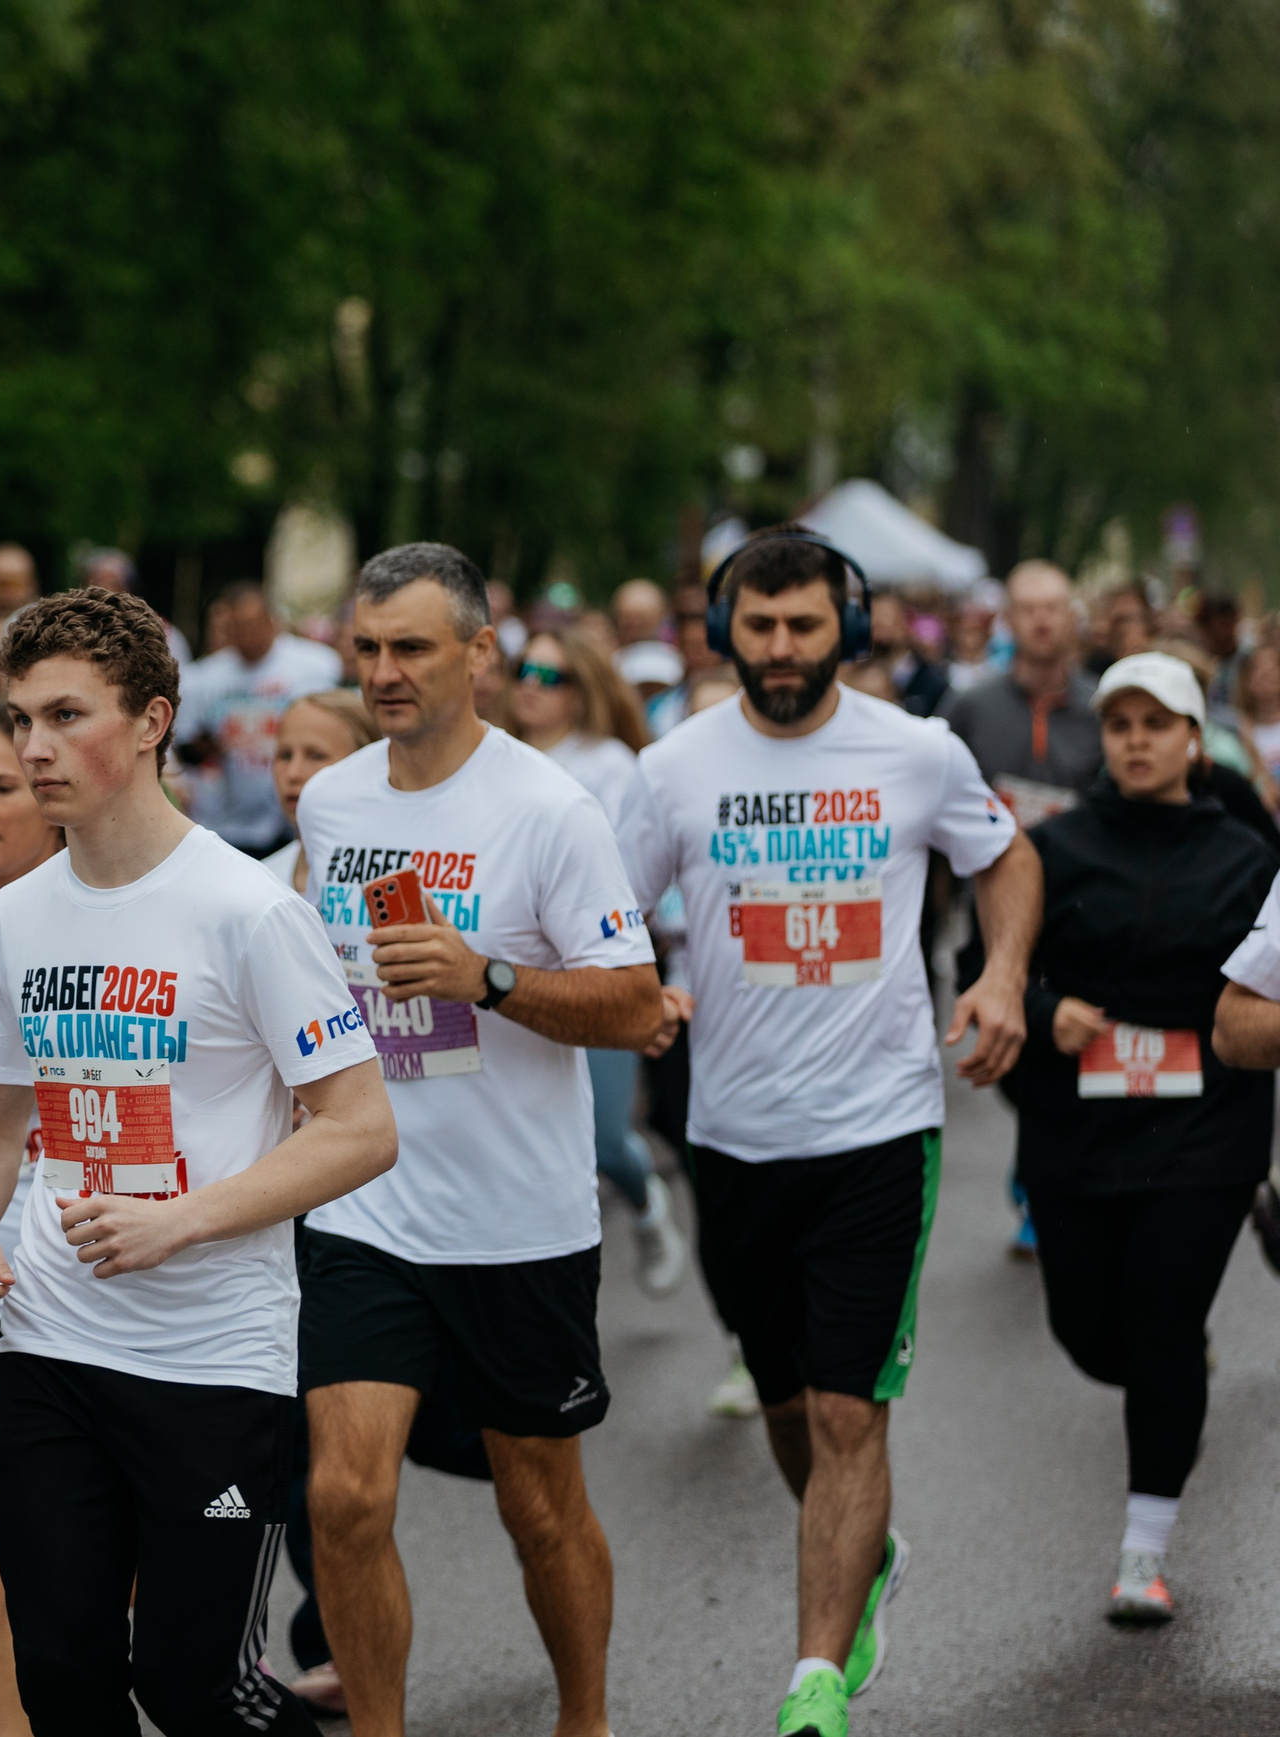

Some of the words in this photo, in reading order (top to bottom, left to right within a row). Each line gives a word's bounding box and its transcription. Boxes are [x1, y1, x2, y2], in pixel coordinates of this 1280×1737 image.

[717, 788, 882, 827] #ЗАБЕГ2025
[710, 830, 760, 866] 45%
[767, 825, 891, 862] ПЛАНЕТЫ
[784, 904, 840, 951] 614
[21, 965, 178, 1017] #ЗАБЕГ2025
[362, 987, 434, 1037] 1440
[56, 1013, 188, 1063] ПЛАНЕТЫ
[49, 1067, 66, 1077] ПСБ
[69, 1087, 122, 1144] 994
[204, 1505, 251, 1519] adidas
